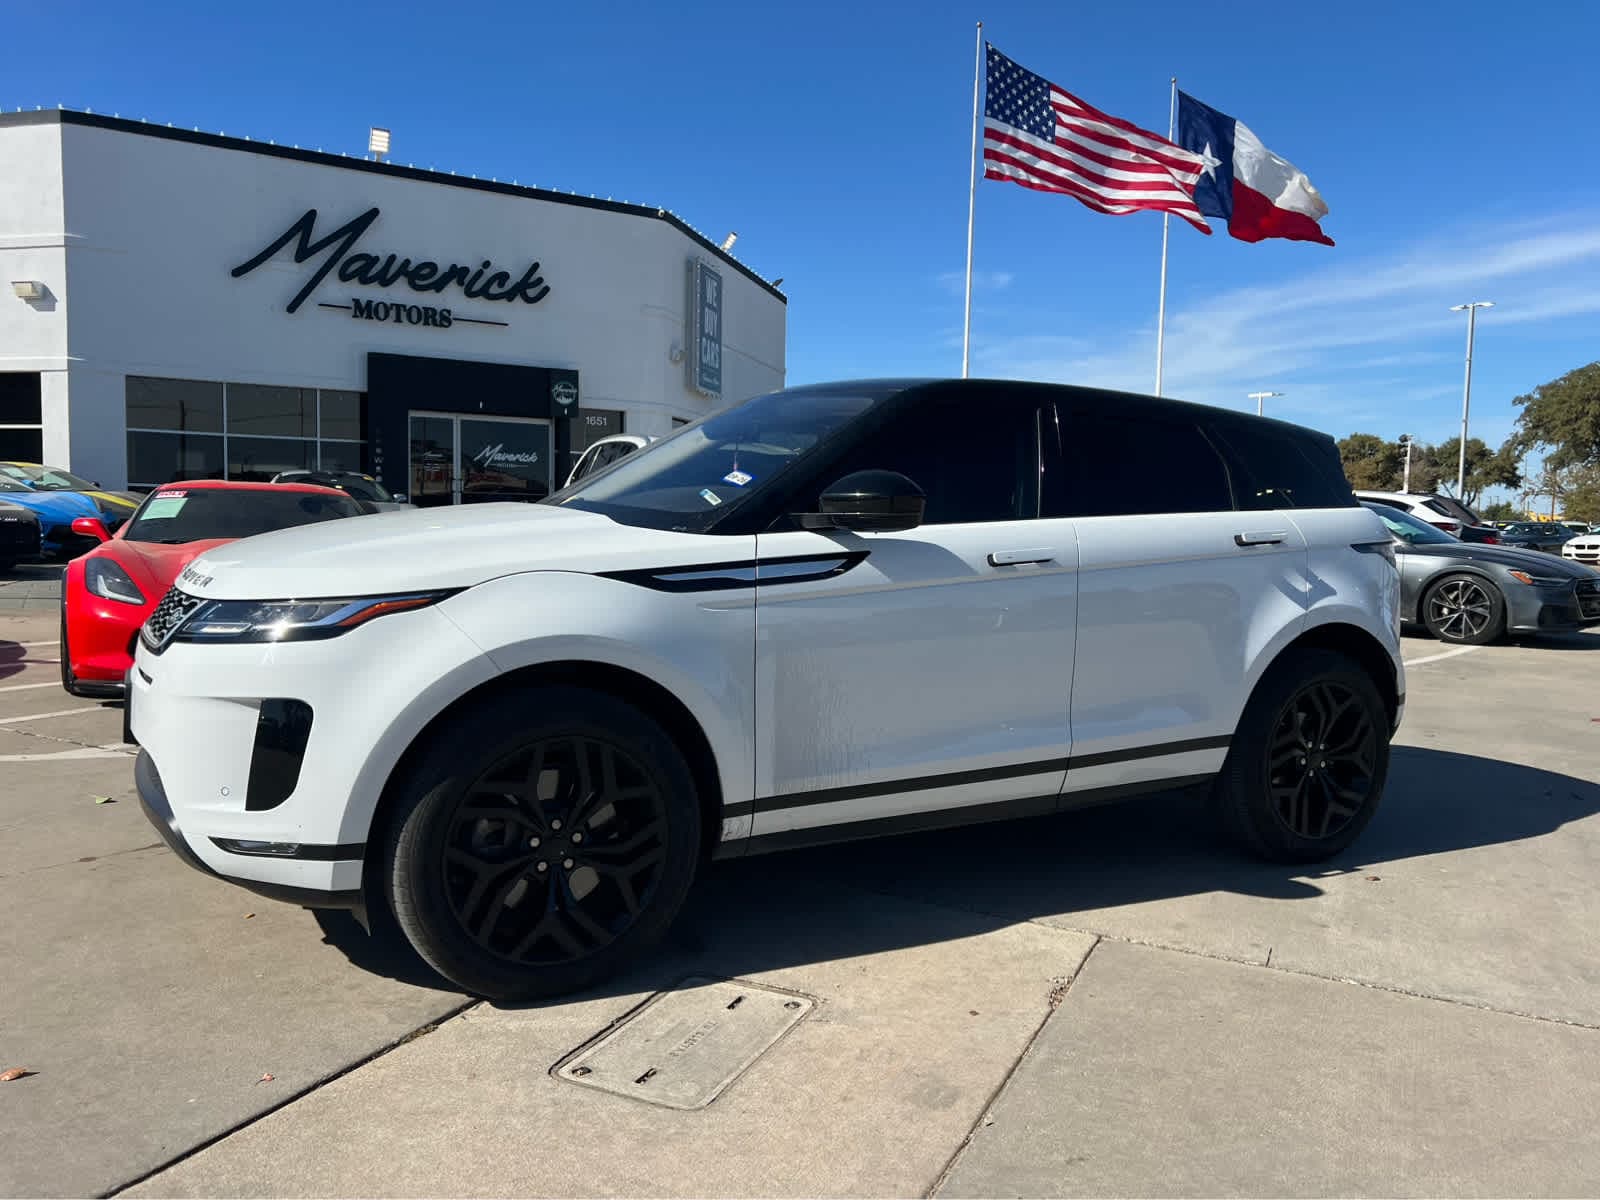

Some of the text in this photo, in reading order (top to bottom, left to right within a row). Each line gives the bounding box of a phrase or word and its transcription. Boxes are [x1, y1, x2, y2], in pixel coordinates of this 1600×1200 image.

[231, 207, 550, 314] Maverick
[705, 275, 718, 307] WE
[352, 298, 452, 328] MOTORS
[702, 337, 719, 369] CARS
[585, 416, 607, 426] 1651
[473, 443, 538, 468] Maverick
